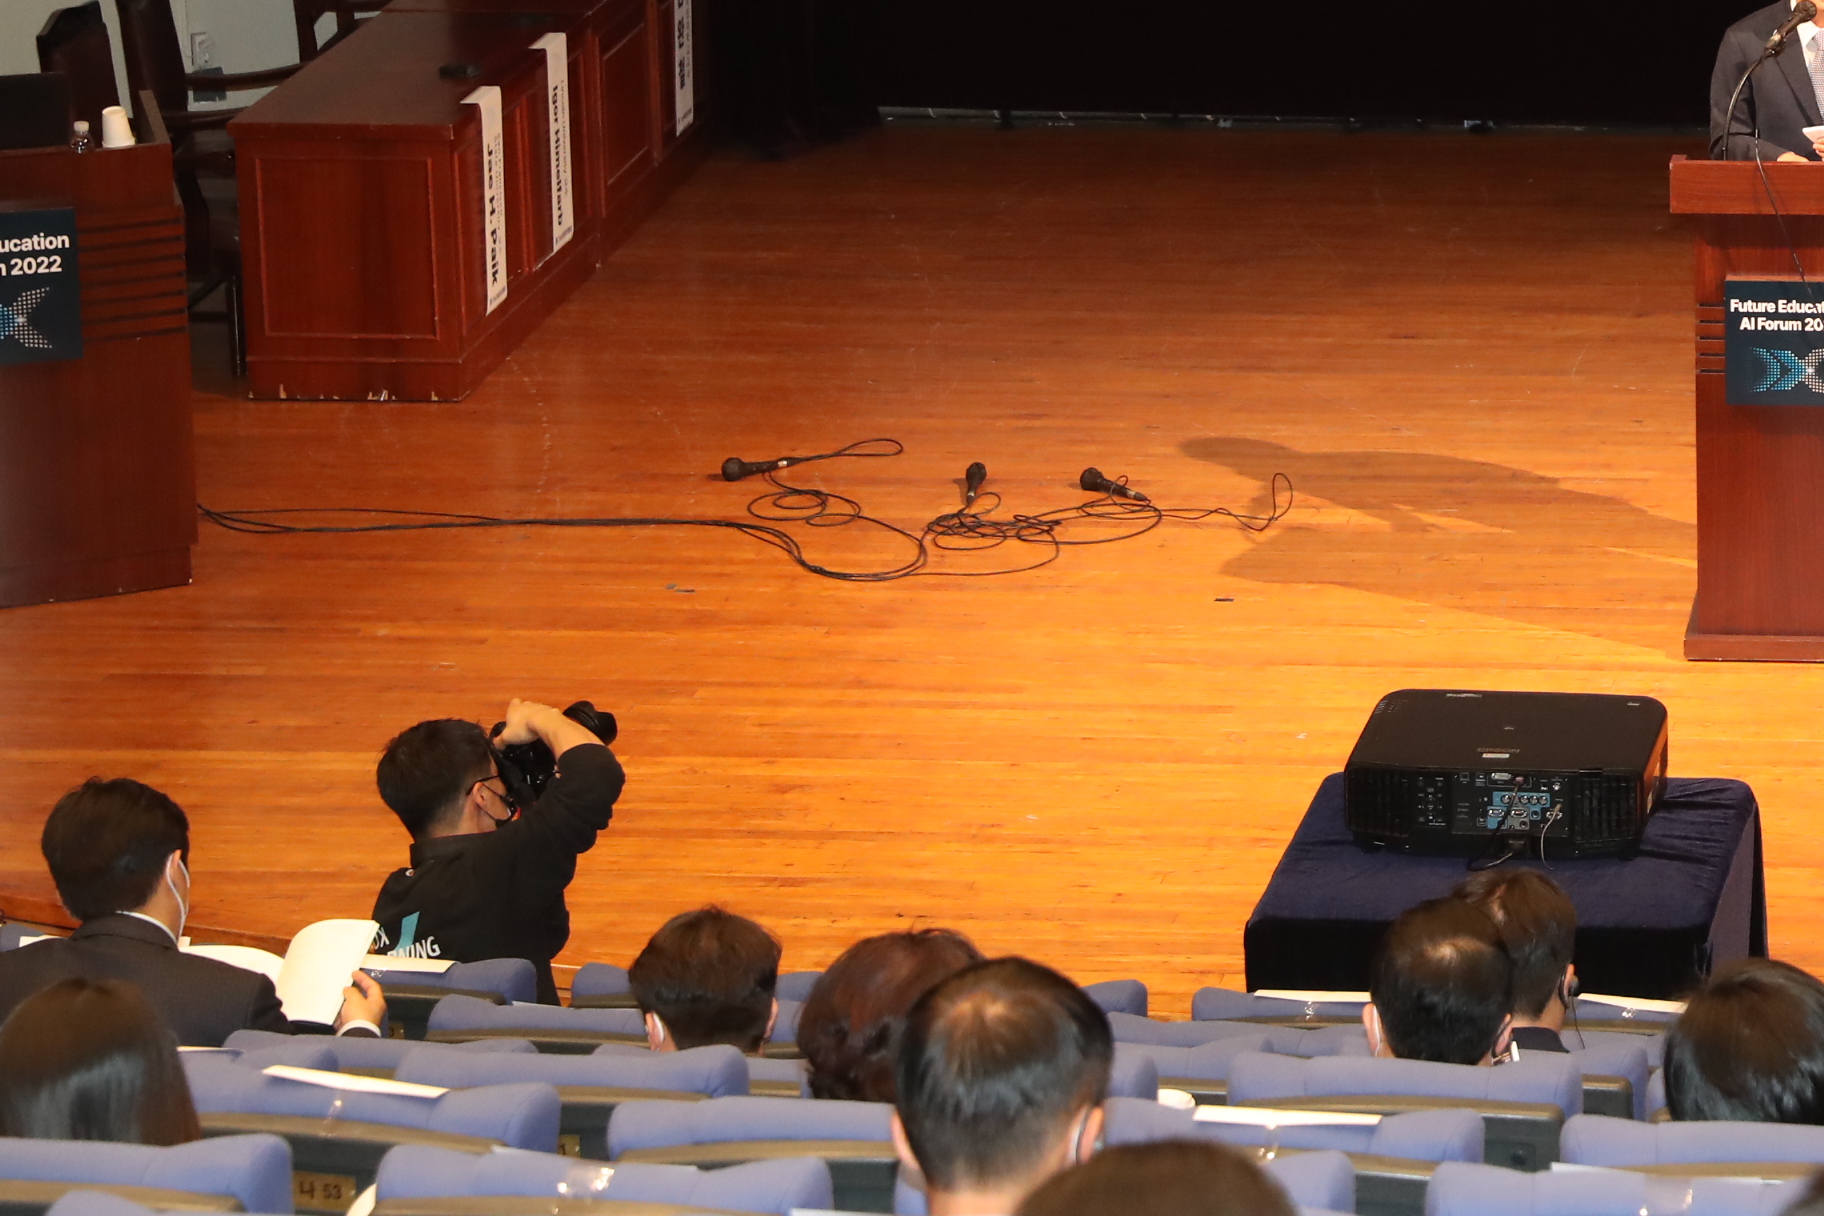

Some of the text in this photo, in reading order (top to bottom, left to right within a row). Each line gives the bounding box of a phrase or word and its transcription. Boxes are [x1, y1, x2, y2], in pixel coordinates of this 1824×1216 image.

[10, 255, 63, 276] 2022
[1730, 299, 1776, 314] Future
[1739, 317, 1756, 331] AI
[1757, 317, 1802, 332] Forum
